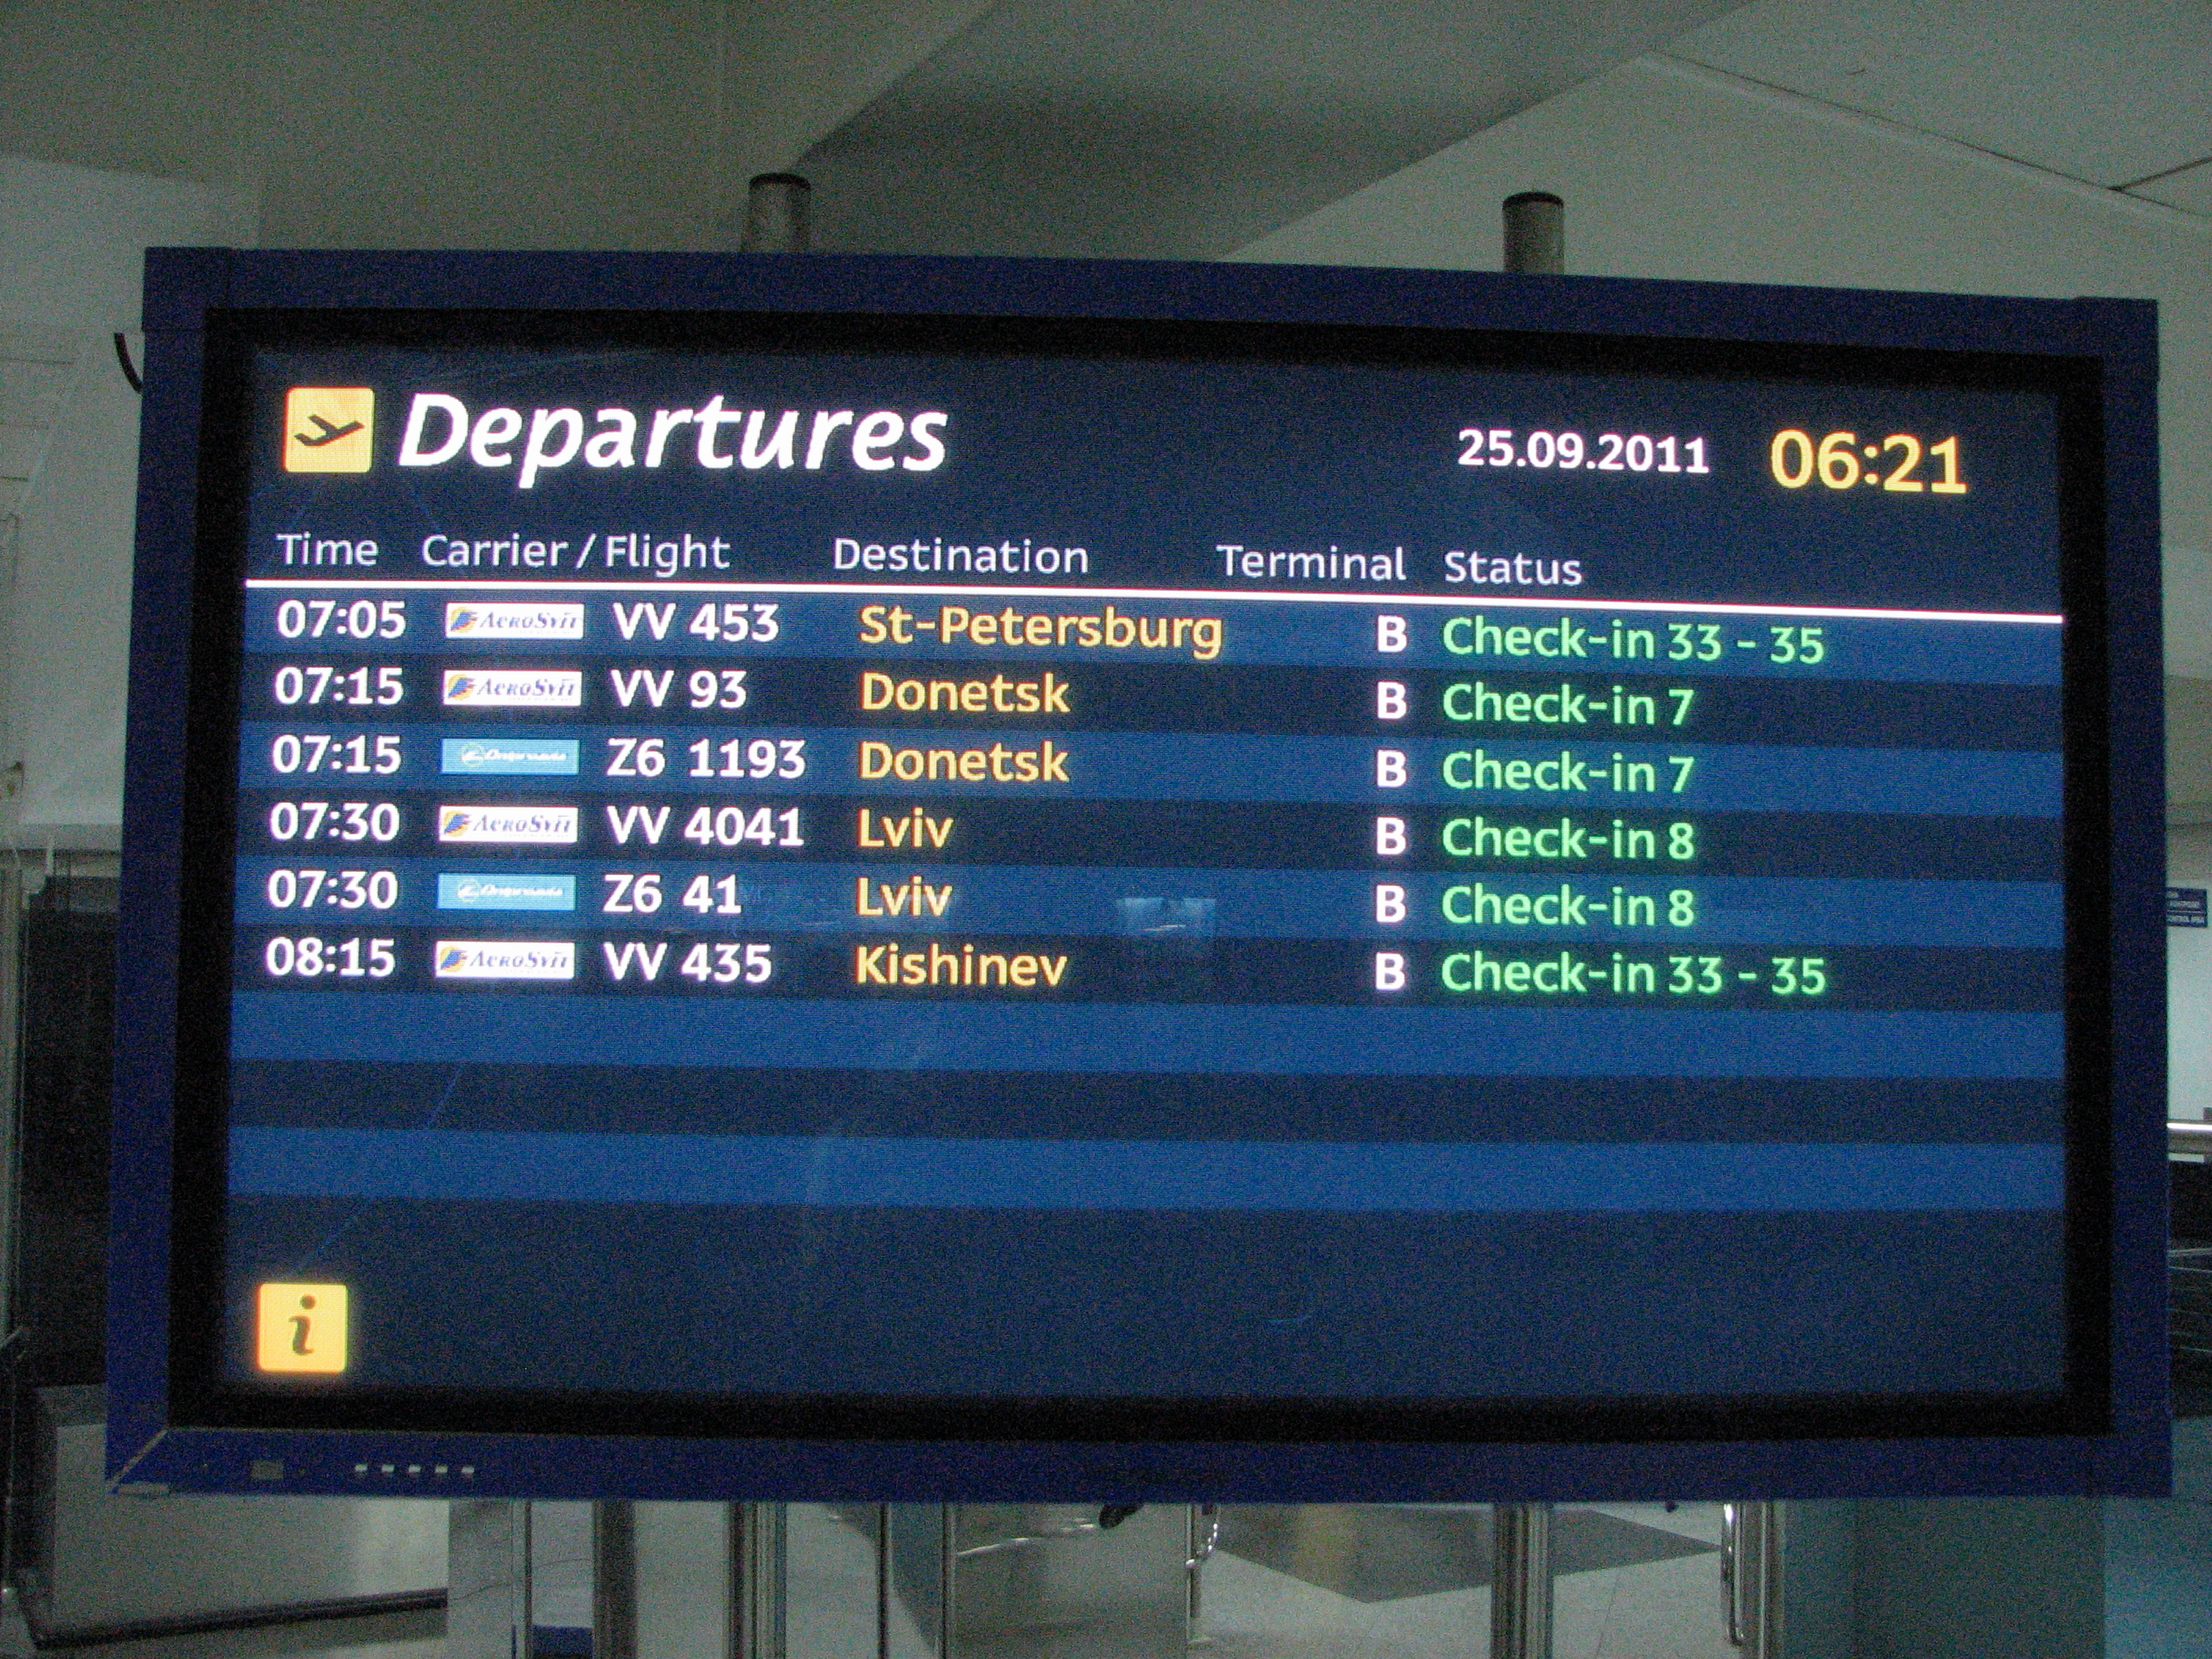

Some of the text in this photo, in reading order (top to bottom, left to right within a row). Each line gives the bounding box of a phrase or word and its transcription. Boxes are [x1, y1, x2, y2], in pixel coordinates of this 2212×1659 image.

[398, 393, 947, 489] Departures
[1458, 428, 1709, 474] 25.09.2011
[1771, 429, 1967, 493] 06:21
[275, 531, 379, 567] Time
[422, 534, 568, 568] Carrier
[605, 534, 731, 578] Flight
[833, 537, 1088, 575] Destination
[1218, 544, 1407, 581] Terminal
[1445, 550, 1582, 587] Status
[276, 599, 406, 639] 07:05
[613, 602, 676, 641] VV
[689, 603, 779, 643] 453
[860, 606, 1224, 660] St-Petersburg
[1377, 615, 1407, 654] B
[1442, 616, 1654, 660] Check-in
[1668, 623, 1722, 662] 33
[1770, 625, 1825, 665] 35
[274, 666, 403, 706] 07:15
[610, 669, 674, 708] VV
[688, 669, 746, 709] 93
[862, 672, 1070, 712] Donetsk
[1377, 681, 1407, 720] B
[1443, 682, 1654, 725] Check-in
[1668, 689, 1694, 725] 7
[271, 734, 1694, 793] 07:15 Z6 1193 Donetsk B Check-in 7
[269, 801, 400, 842] 07:30
[606, 805, 671, 844] VV
[683, 806, 804, 847] 4041
[859, 807, 953, 848] Lviv
[1376, 816, 1406, 855] B
[1443, 816, 1655, 859] Check-in
[1668, 822, 1694, 860] 8
[266, 869, 1694, 927] 07:30 Z6 41 Lviv B Check-in 8
[265, 936, 395, 978] 08:15
[602, 942, 668, 982] VV
[680, 943, 771, 984] 435
[856, 943, 1067, 987] Kishinev
[1375, 952, 1405, 992] B
[1441, 950, 1654, 994] Check-in
[1668, 956, 1723, 994] 33
[1772, 958, 1826, 996] 35
